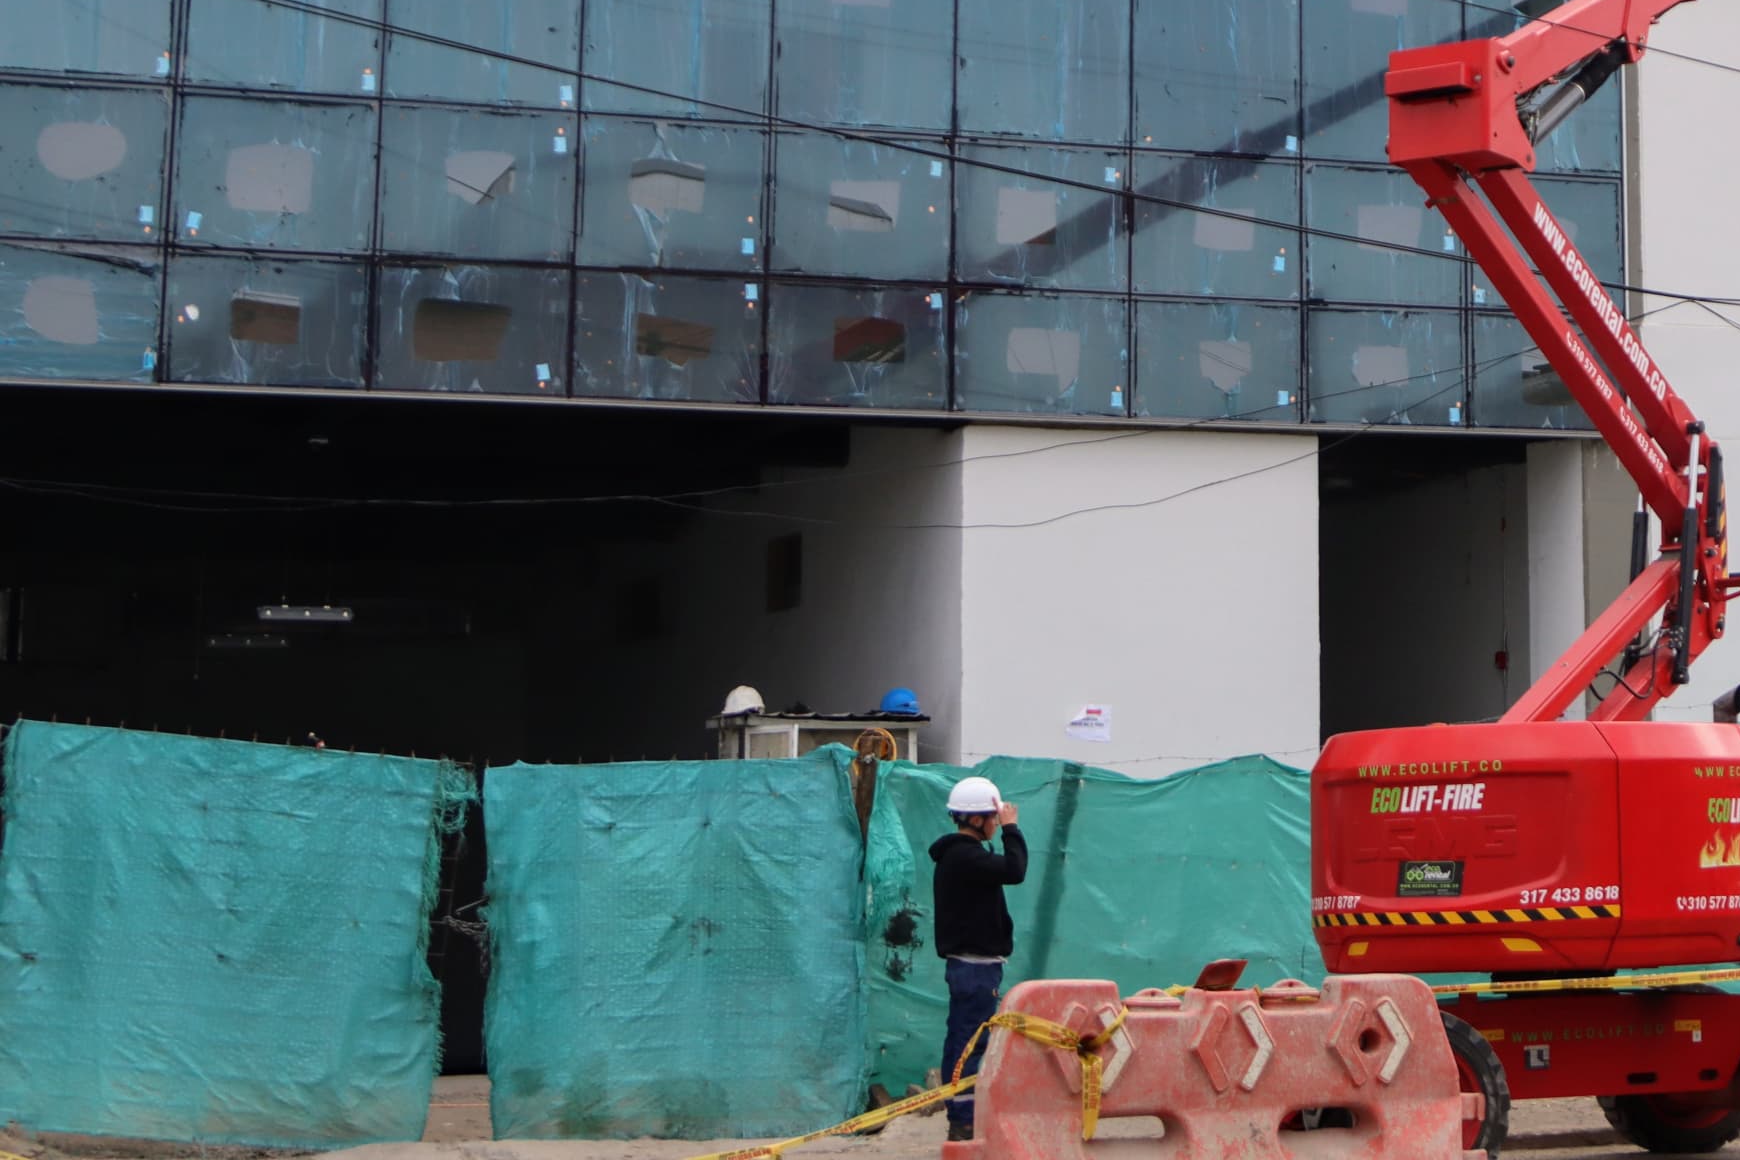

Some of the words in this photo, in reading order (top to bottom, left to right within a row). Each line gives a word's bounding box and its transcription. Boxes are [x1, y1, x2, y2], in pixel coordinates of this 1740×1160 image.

[1533, 201, 1668, 401] www.ecorental.com.co
[1358, 759, 1503, 778] WWW.ECOLIFT.CO
[1370, 782, 1486, 814] ECOLIFT-FIRE
[1520, 889, 1546, 904] 317
[1551, 888, 1581, 902] 433
[1584, 886, 1620, 901] 8618
[1687, 895, 1707, 911] 310
[1708, 895, 1727, 910] 577
